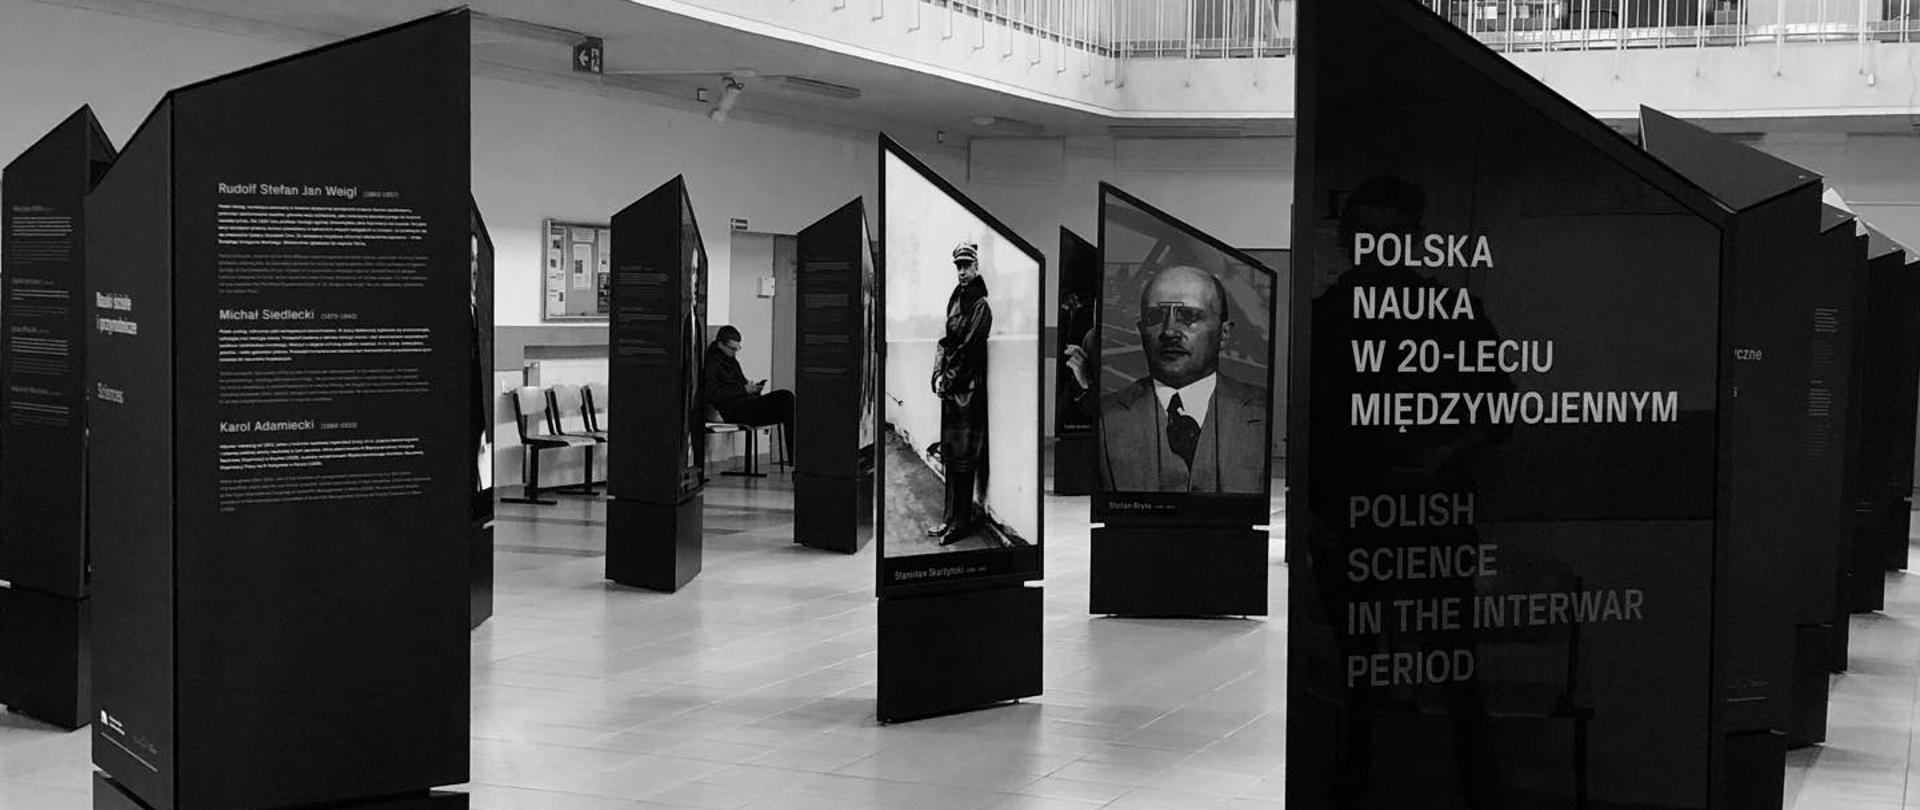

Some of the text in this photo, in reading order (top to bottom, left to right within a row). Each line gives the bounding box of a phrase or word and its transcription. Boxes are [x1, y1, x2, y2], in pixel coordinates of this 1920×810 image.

[218, 182, 257, 195] Rudolf
[259, 183, 299, 196] Stefan
[302, 185, 322, 196] Jan
[324, 185, 358, 200] Weigl
[1354, 232, 1494, 268] POLSKA
[219, 309, 259, 320] Michał
[262, 308, 315, 320] Siedlecki
[1353, 286, 1475, 320] NAUKA
[1351, 338, 1554, 373] W 20-LECIU
[1734, 348, 1763, 361] czne
[220, 421, 251, 433] Karol
[254, 420, 315, 432] Adamiecki
[1351, 390, 1679, 433] MIĘDZYWOJENNYM
[1349, 492, 1475, 528] POLISH
[1348, 544, 1499, 582] SCIENCE
[1348, 588, 1645, 635] IN THE INTERWAR
[1347, 649, 1475, 688] PERIOD
